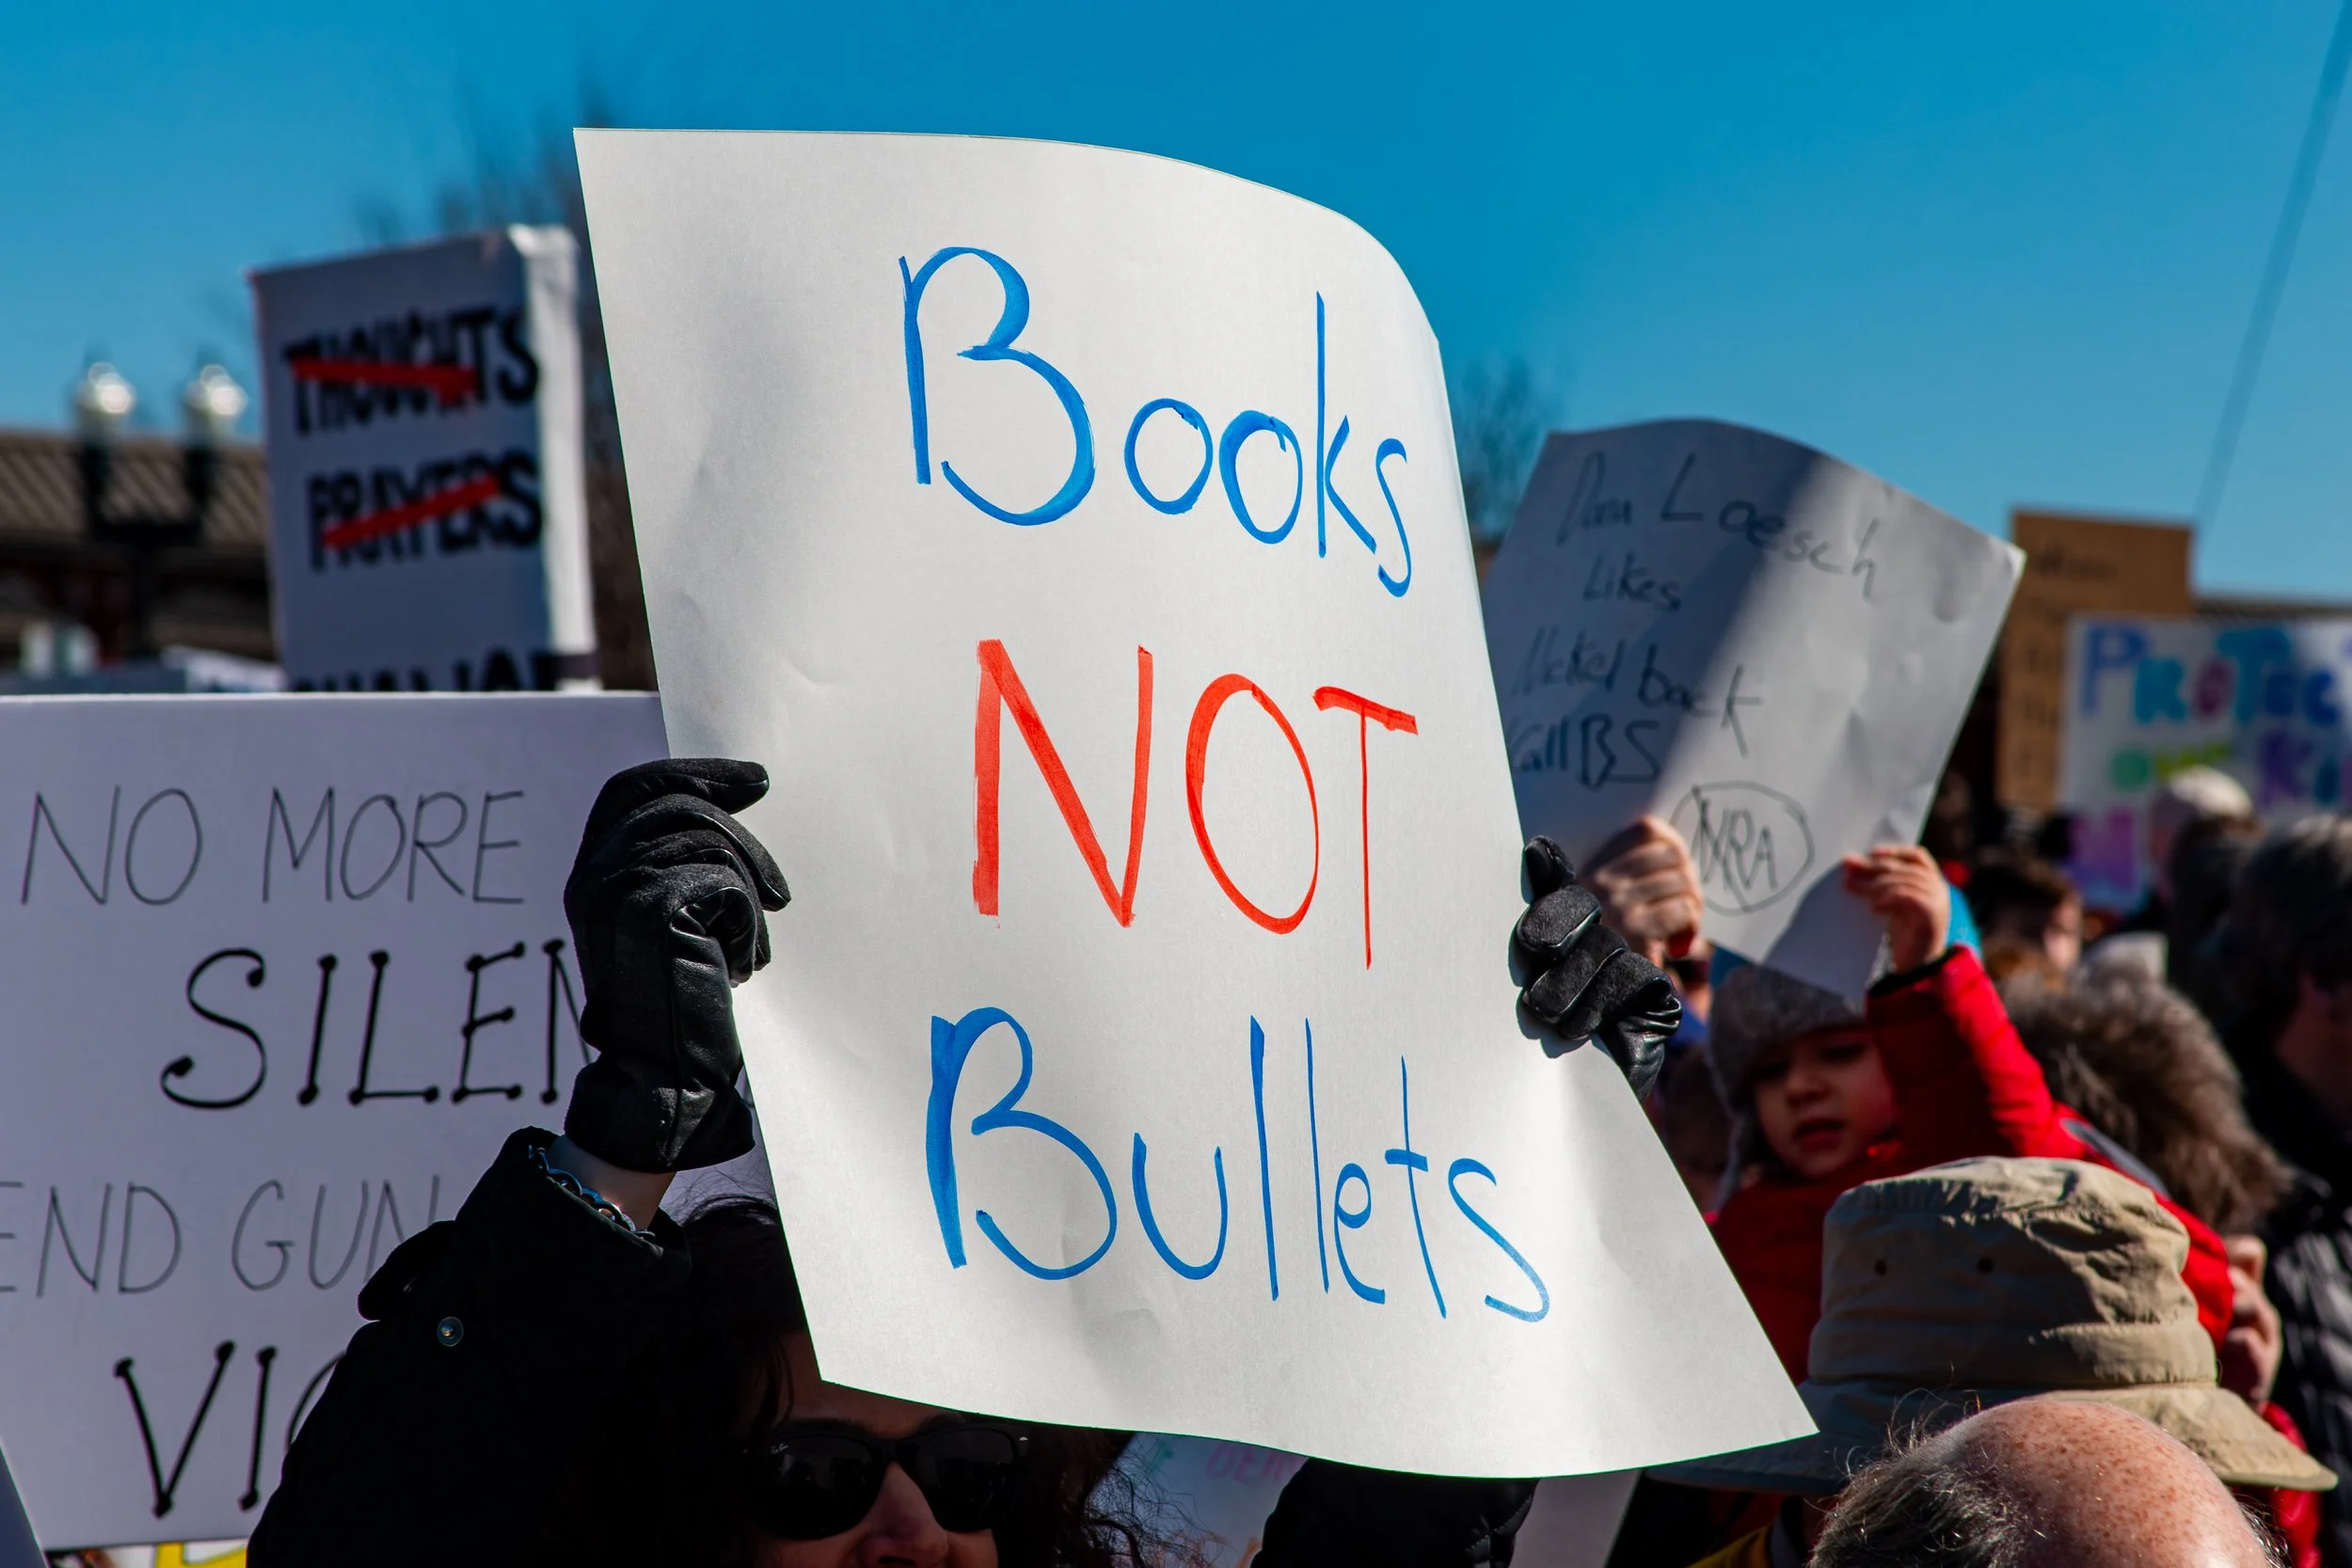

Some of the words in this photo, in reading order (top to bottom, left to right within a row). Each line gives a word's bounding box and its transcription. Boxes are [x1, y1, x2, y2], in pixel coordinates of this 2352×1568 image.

[898, 246, 1413, 597] Books
[307, 449, 544, 570] PRAYERS
[1660, 453, 1877, 602] Loesch
[2078, 623, 2352, 725] PROTEC
[23, 785, 202, 906] NO
[262, 786, 525, 904] MORE
[973, 639, 1419, 970] NOT
[231, 1174, 440, 1291] GUN
[925, 1006, 1549, 1323] Bullets
[115, 1340, 348, 1517] VI
